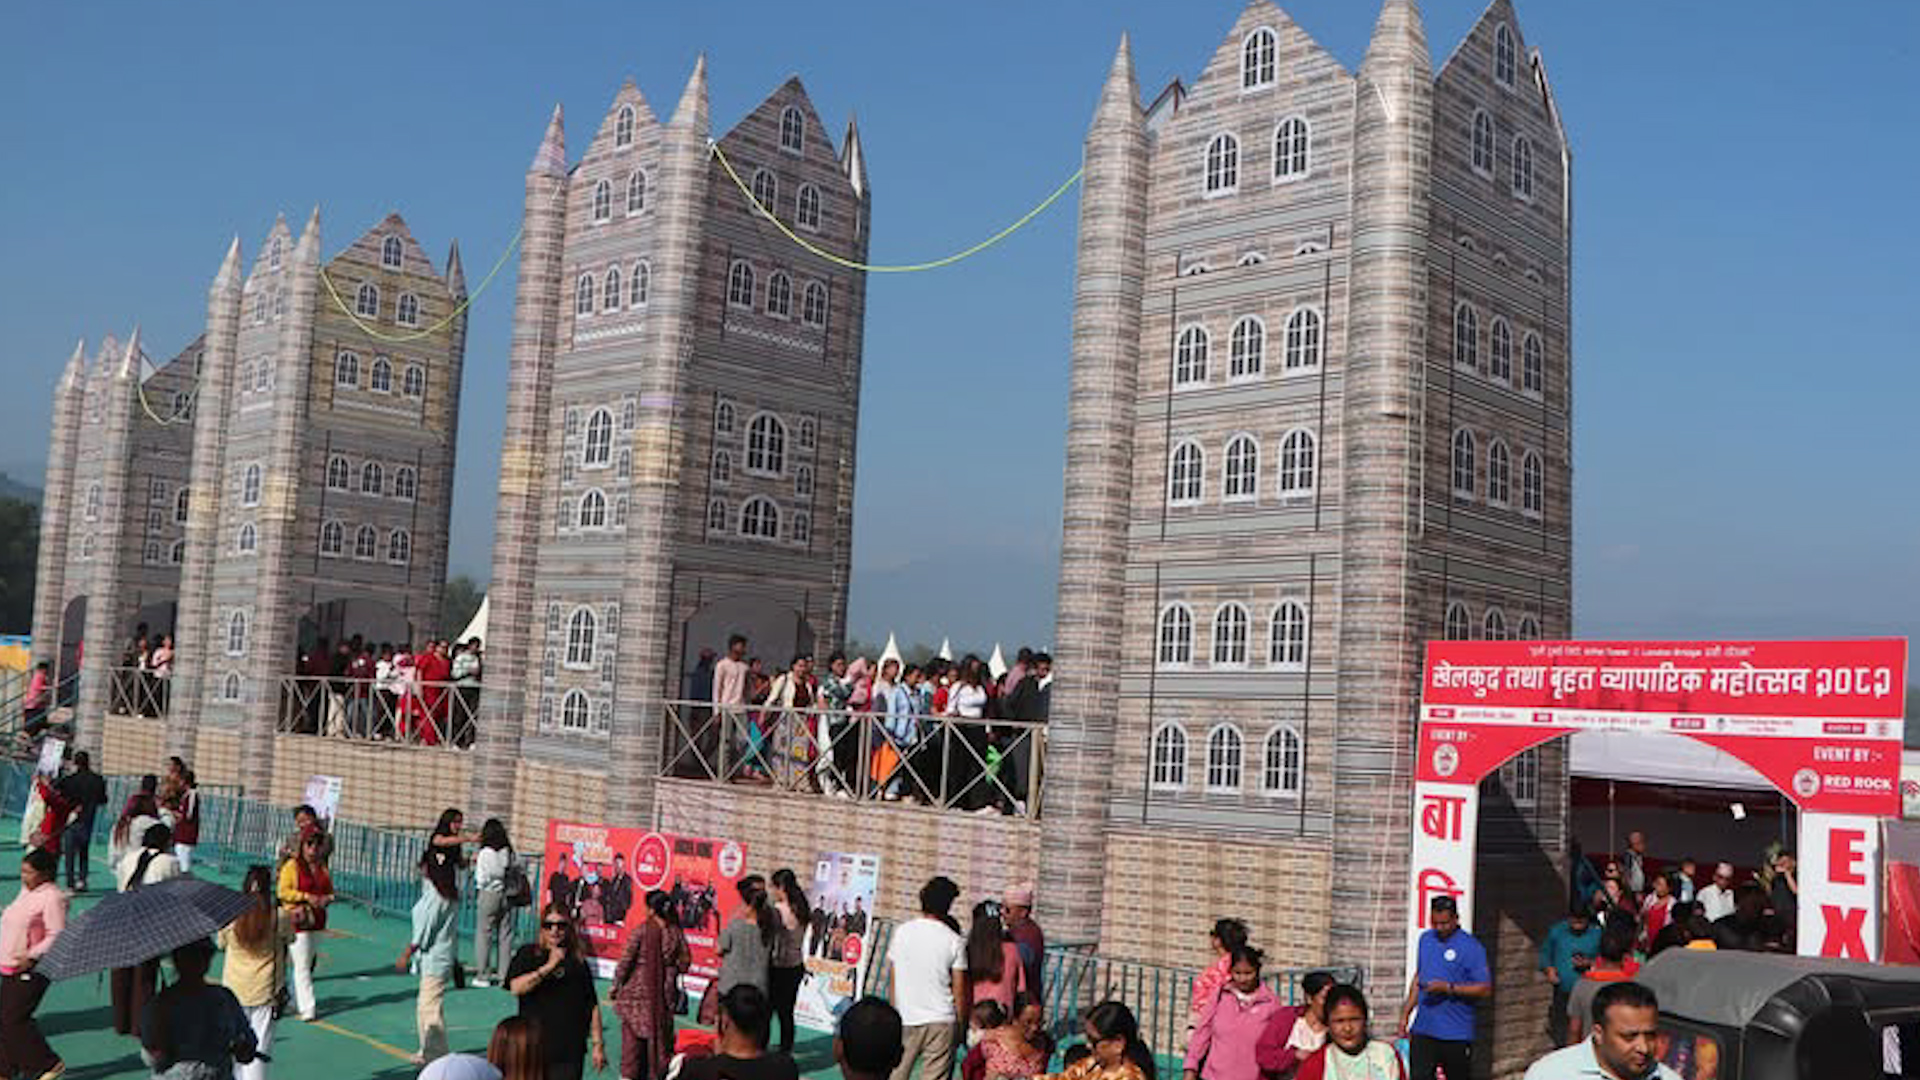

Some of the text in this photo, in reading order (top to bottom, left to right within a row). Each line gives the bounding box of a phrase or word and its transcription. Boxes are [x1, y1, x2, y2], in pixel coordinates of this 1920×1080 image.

[1432, 660, 1502, 698] खेलकुद
[1505, 665, 1547, 690] तथा
[1550, 666, 1597, 699] बृहत
[1600, 661, 1707, 693] व्यापारिक
[1710, 661, 1812, 697] महोत्सव
[1429, 728, 1455, 742] EVENT
[1813, 745, 1851, 761] EVENT
[1853, 747, 1870, 762] BY
[1824, 774, 1893, 790] RED ROCK
